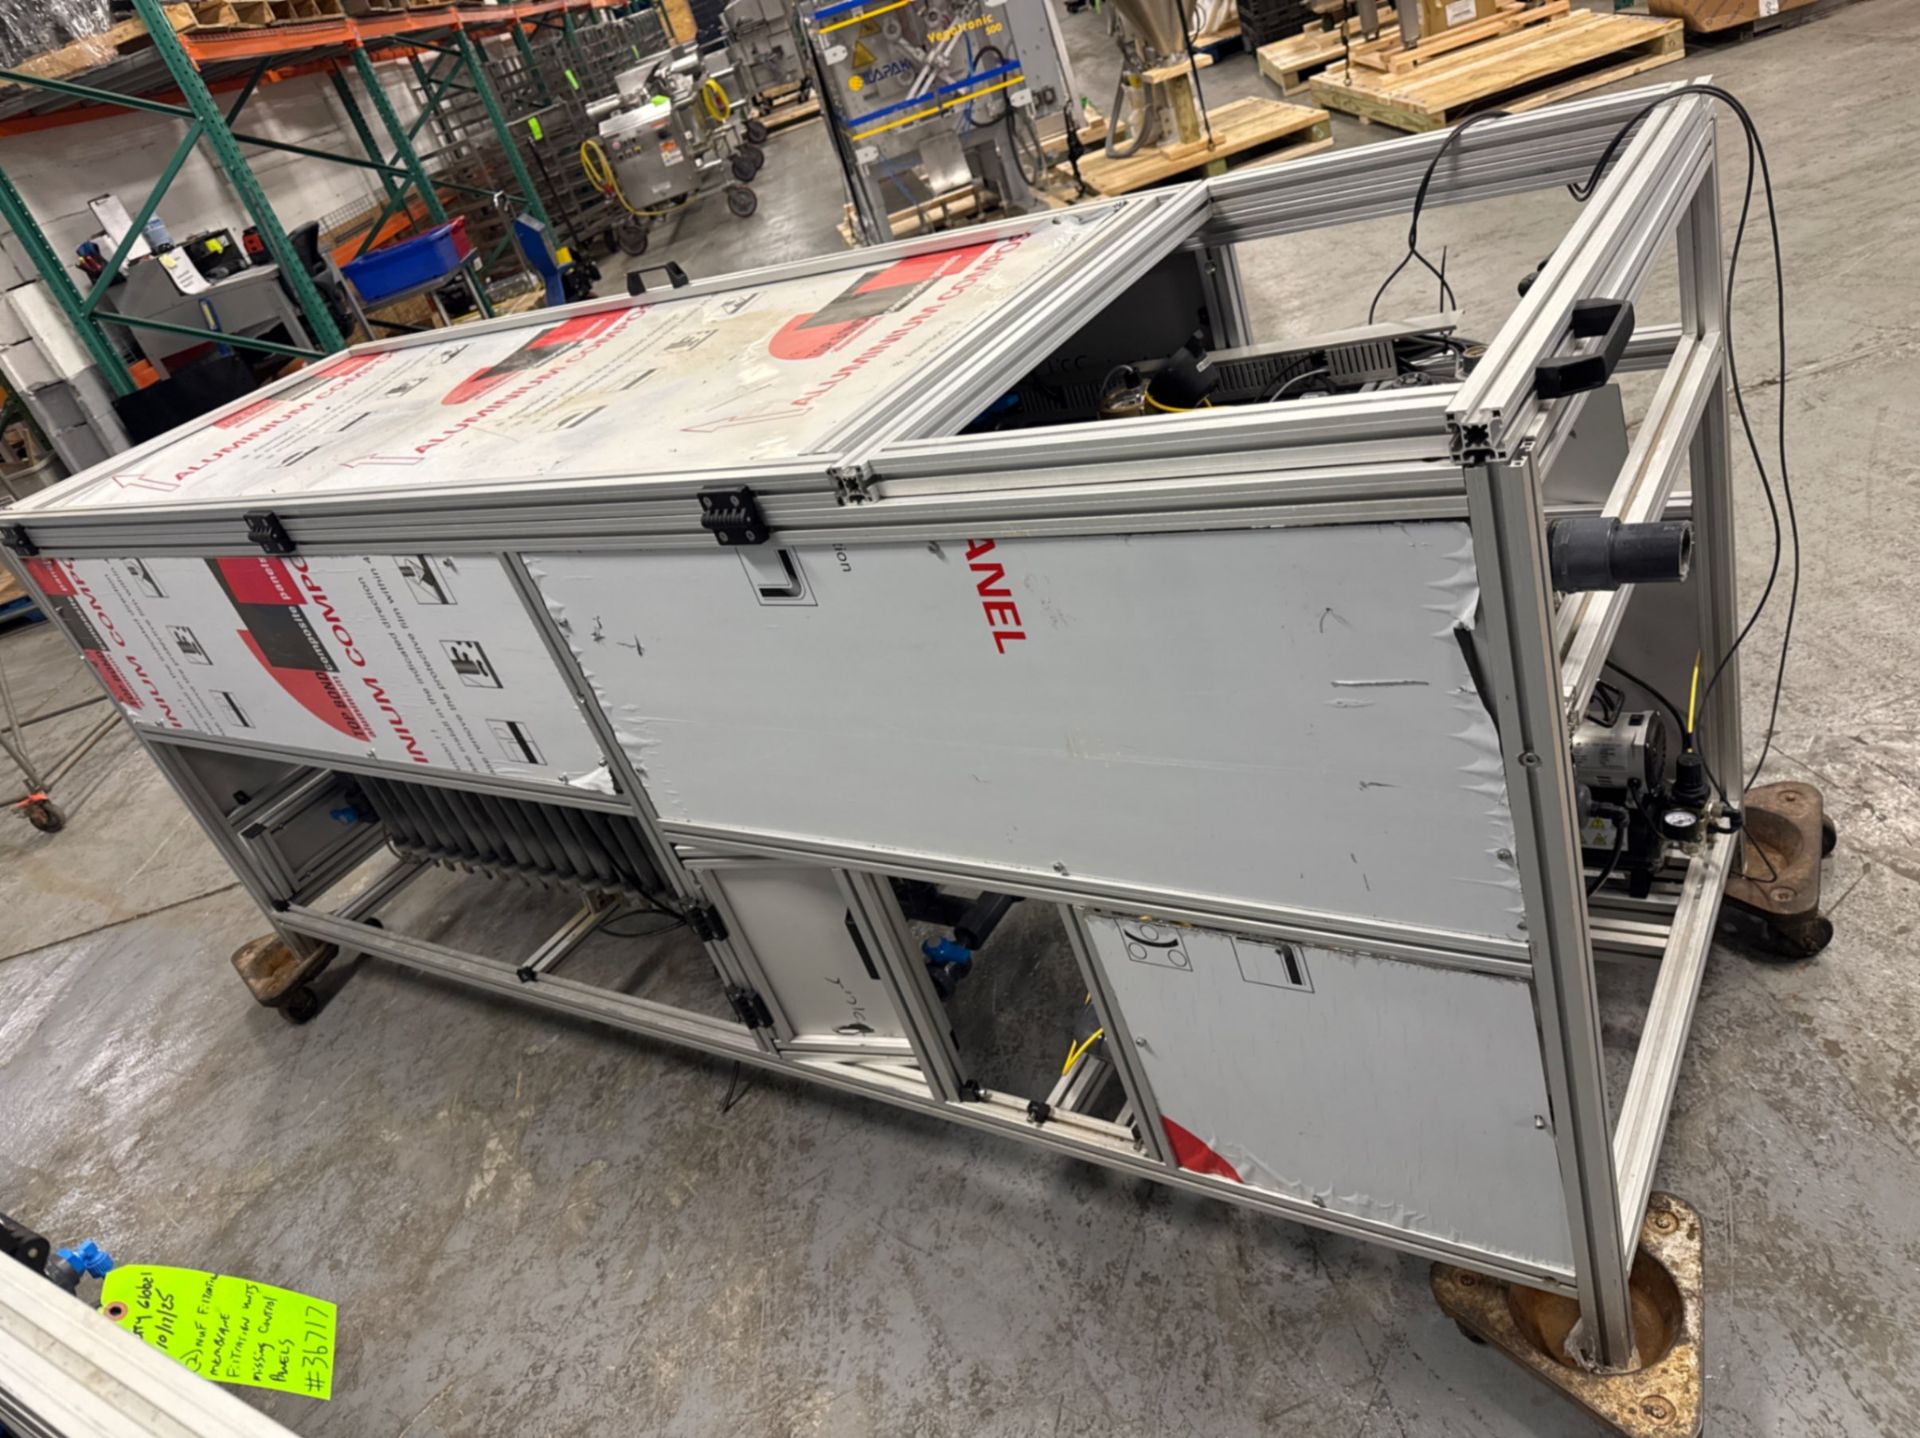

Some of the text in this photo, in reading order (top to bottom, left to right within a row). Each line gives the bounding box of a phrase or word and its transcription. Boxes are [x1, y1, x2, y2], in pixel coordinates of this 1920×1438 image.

[791, 303, 945, 406] ALUMINIUM
[175, 401, 314, 481] ALUMINIUM
[415, 366, 566, 454] ALUMINIUM
[288, 605, 334, 672] composite
[315, 671, 366, 737] TOP BOND
[300, 1304, 330, 1393] #36717
